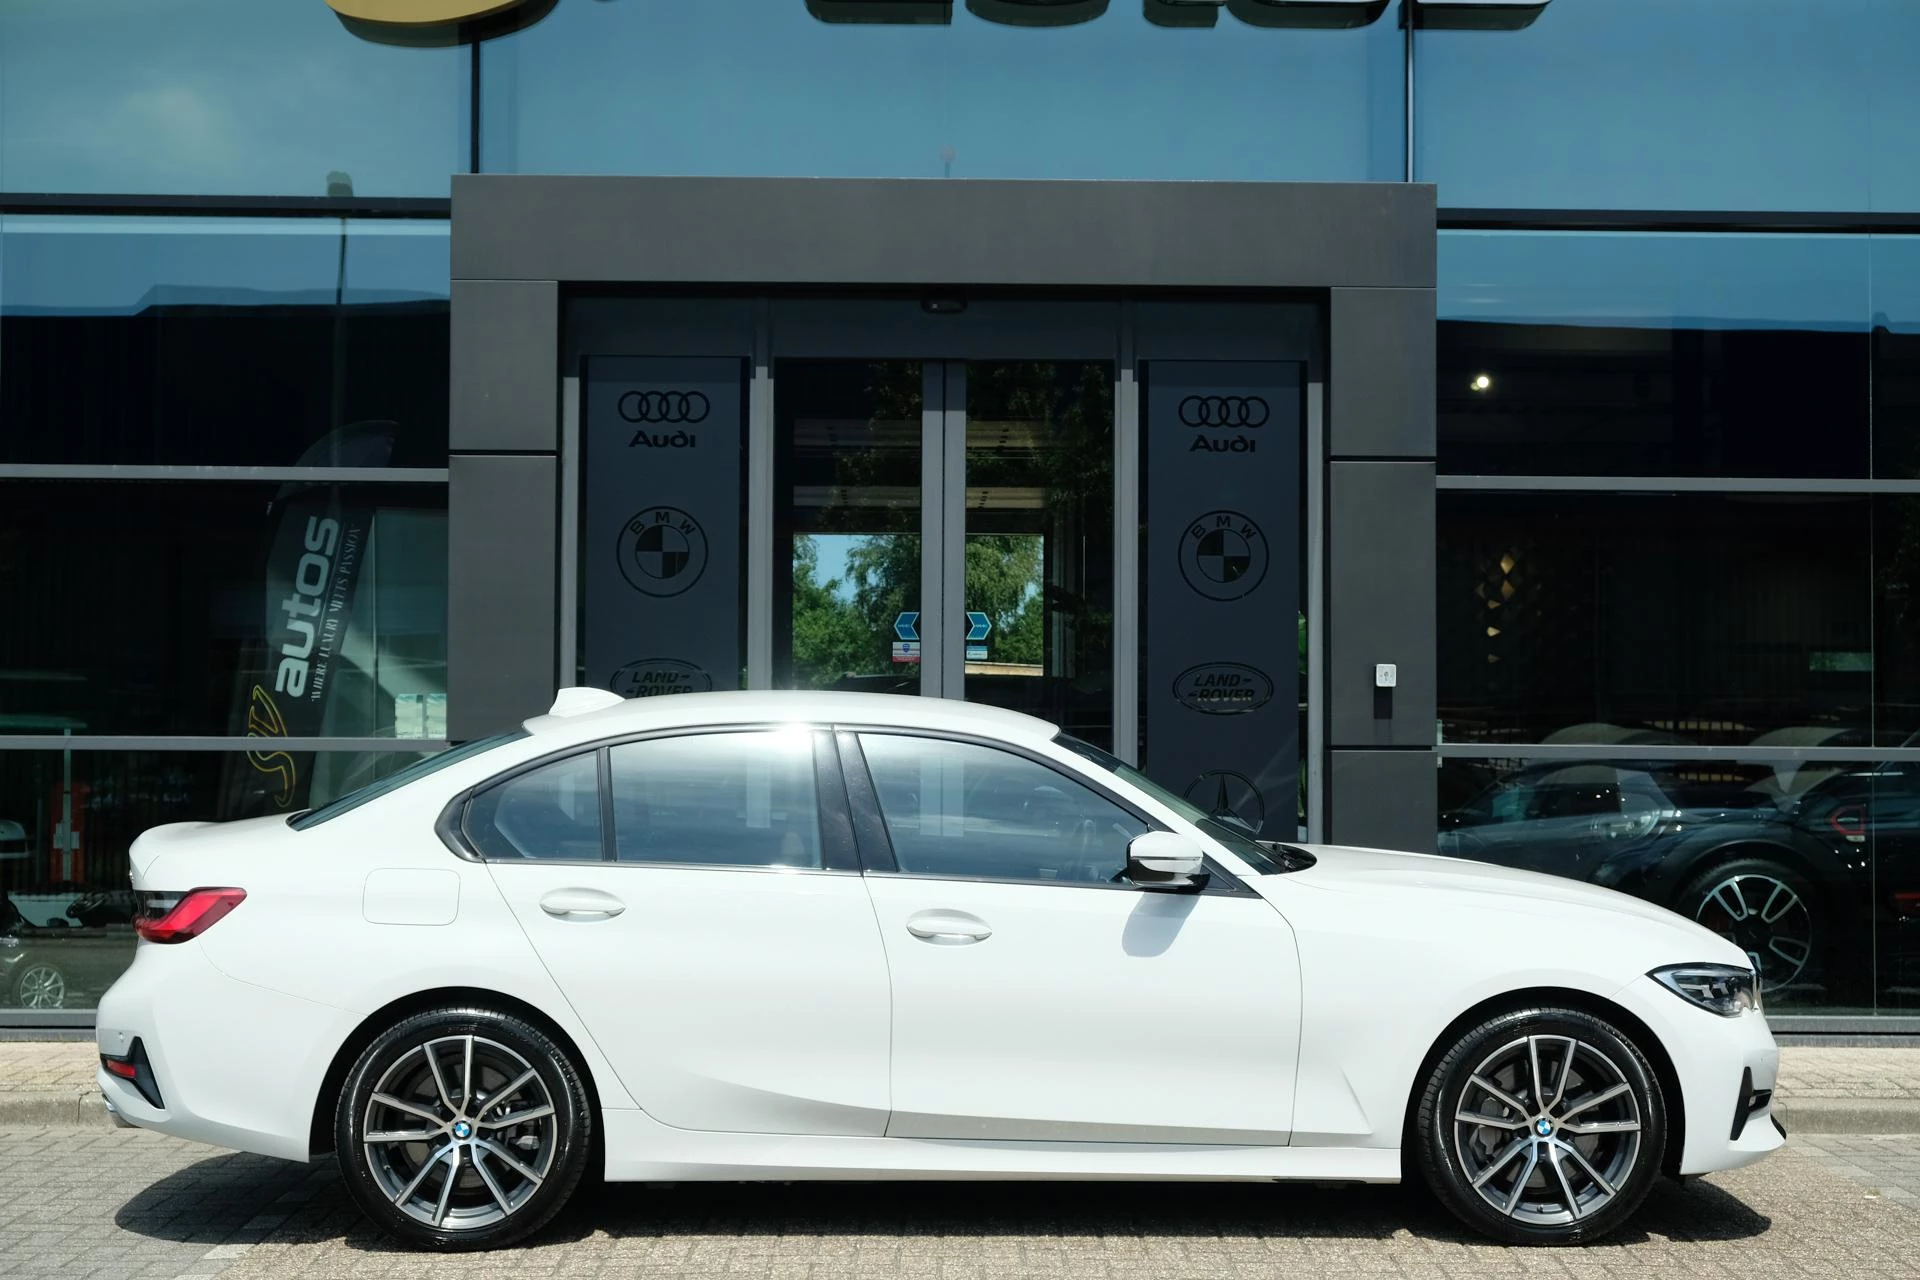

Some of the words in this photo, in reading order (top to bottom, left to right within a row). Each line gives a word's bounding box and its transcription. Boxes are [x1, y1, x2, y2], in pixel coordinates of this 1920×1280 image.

[629, 430, 695, 447] Audi
[1189, 434, 1255, 452] Audi
[630, 511, 696, 535] BMW
[1190, 515, 1257, 538] BMW
[275, 515, 341, 699] autos
